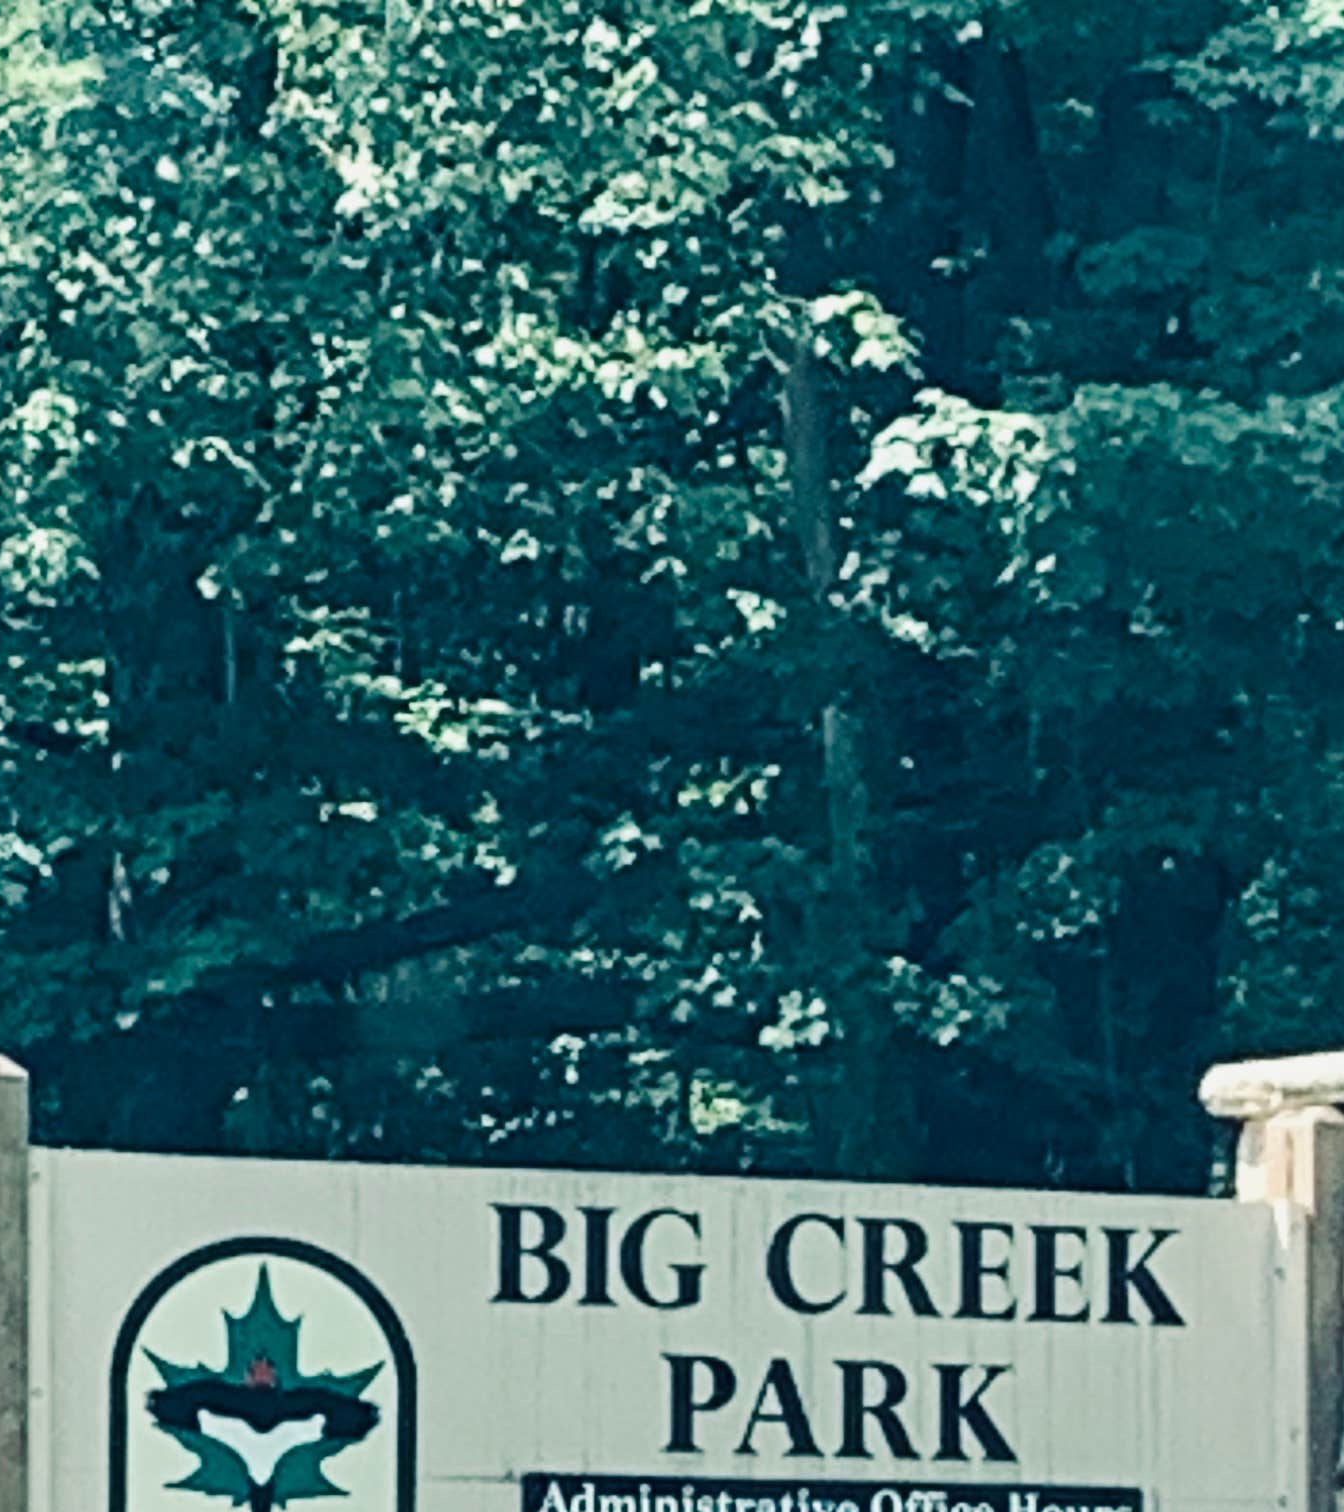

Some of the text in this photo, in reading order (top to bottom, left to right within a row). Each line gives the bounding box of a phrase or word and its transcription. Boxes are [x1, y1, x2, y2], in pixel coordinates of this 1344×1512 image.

[488, 1202, 1186, 1327] BIG CREEK
[660, 1352, 1020, 1463] PARK
